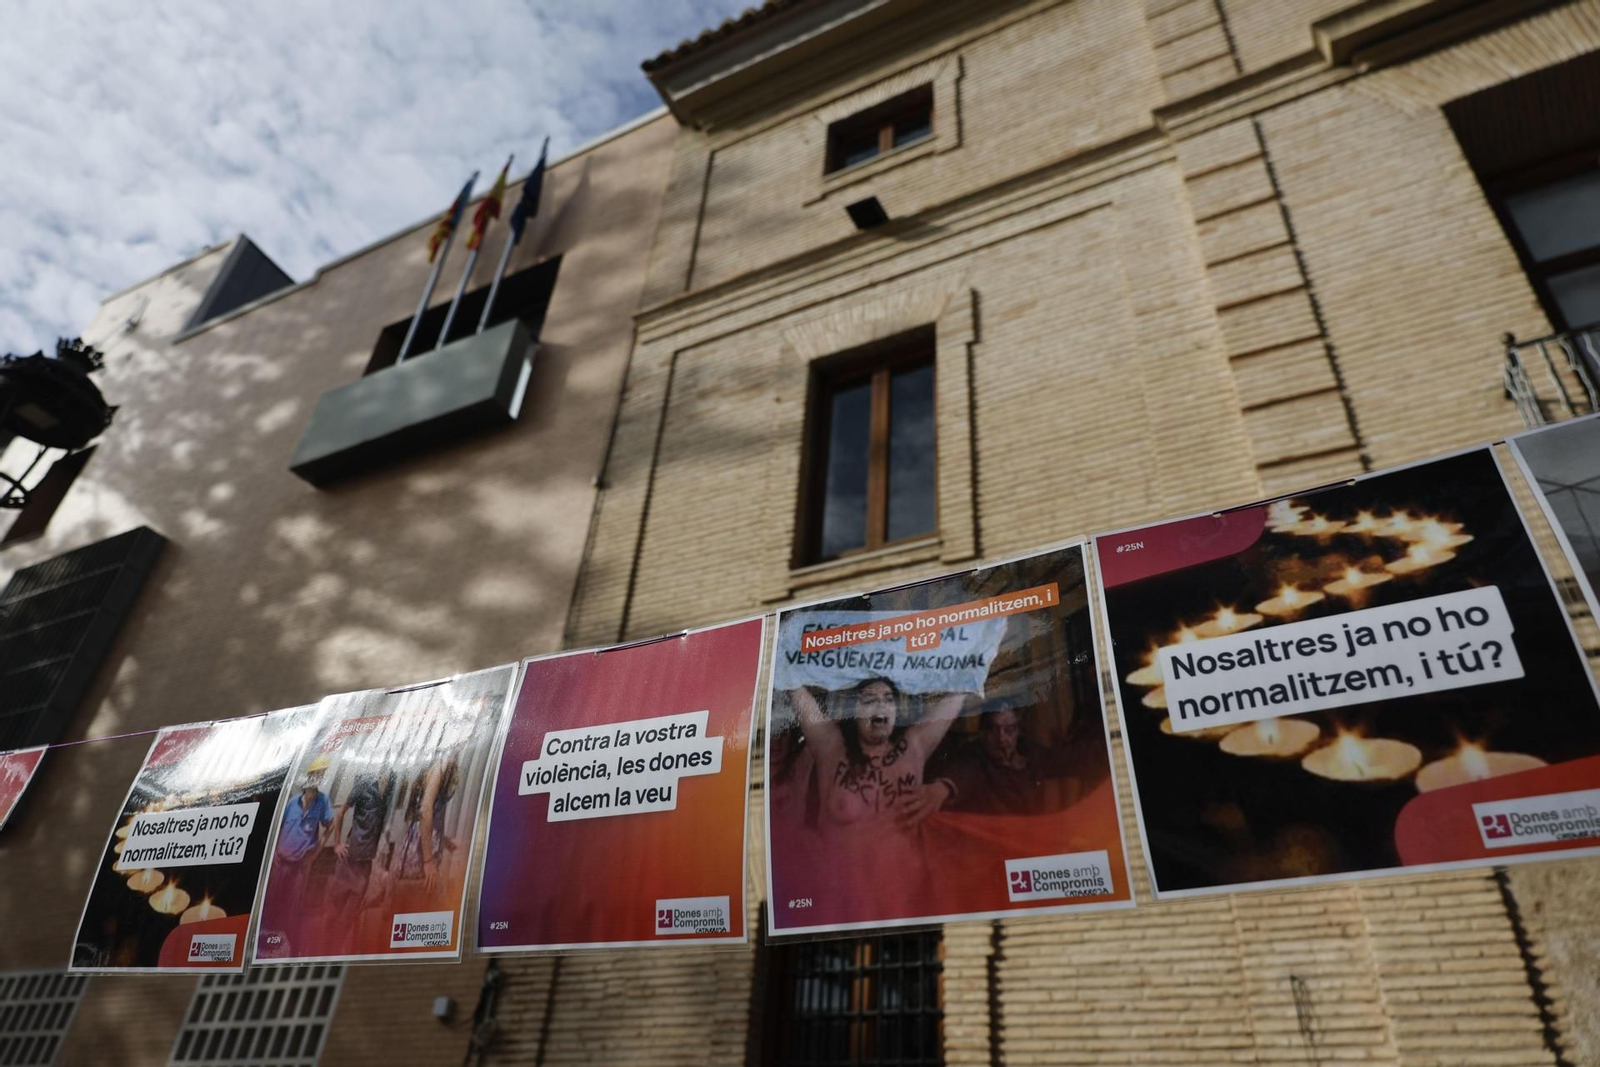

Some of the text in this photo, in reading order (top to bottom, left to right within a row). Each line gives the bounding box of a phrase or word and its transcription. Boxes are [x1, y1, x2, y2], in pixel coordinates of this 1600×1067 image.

[1116, 541, 1145, 554] #25N
[805, 627, 876, 649] Nosaltres
[876, 624, 892, 643] ja
[893, 619, 914, 633] no
[916, 612, 936, 629] ho
[938, 592, 1044, 624] normalitzem,
[1046, 589, 1052, 602] i
[910, 632, 937, 648] tú?
[1170, 605, 1490, 680] Nosaltres ja no ho
[903, 653, 986, 670] NACIONAL
[1178, 640, 1504, 720] normalitzem, i tú?
[546, 723, 697, 756] Contra la vostra
[526, 750, 713, 786] violència, les dones
[554, 786, 672, 813] alcem la veu
[132, 811, 249, 836] Nosaltres ja no ho
[1509, 804, 1598, 825] Dones amb
[122, 836, 243, 862] normalitzem, i tú?
[1032, 865, 1100, 881] Dones amb
[674, 907, 723, 918] Dones amb
[788, 897, 813, 909] #25N
[407, 923, 429, 931] Dones
[490, 921, 508, 930] #25N
